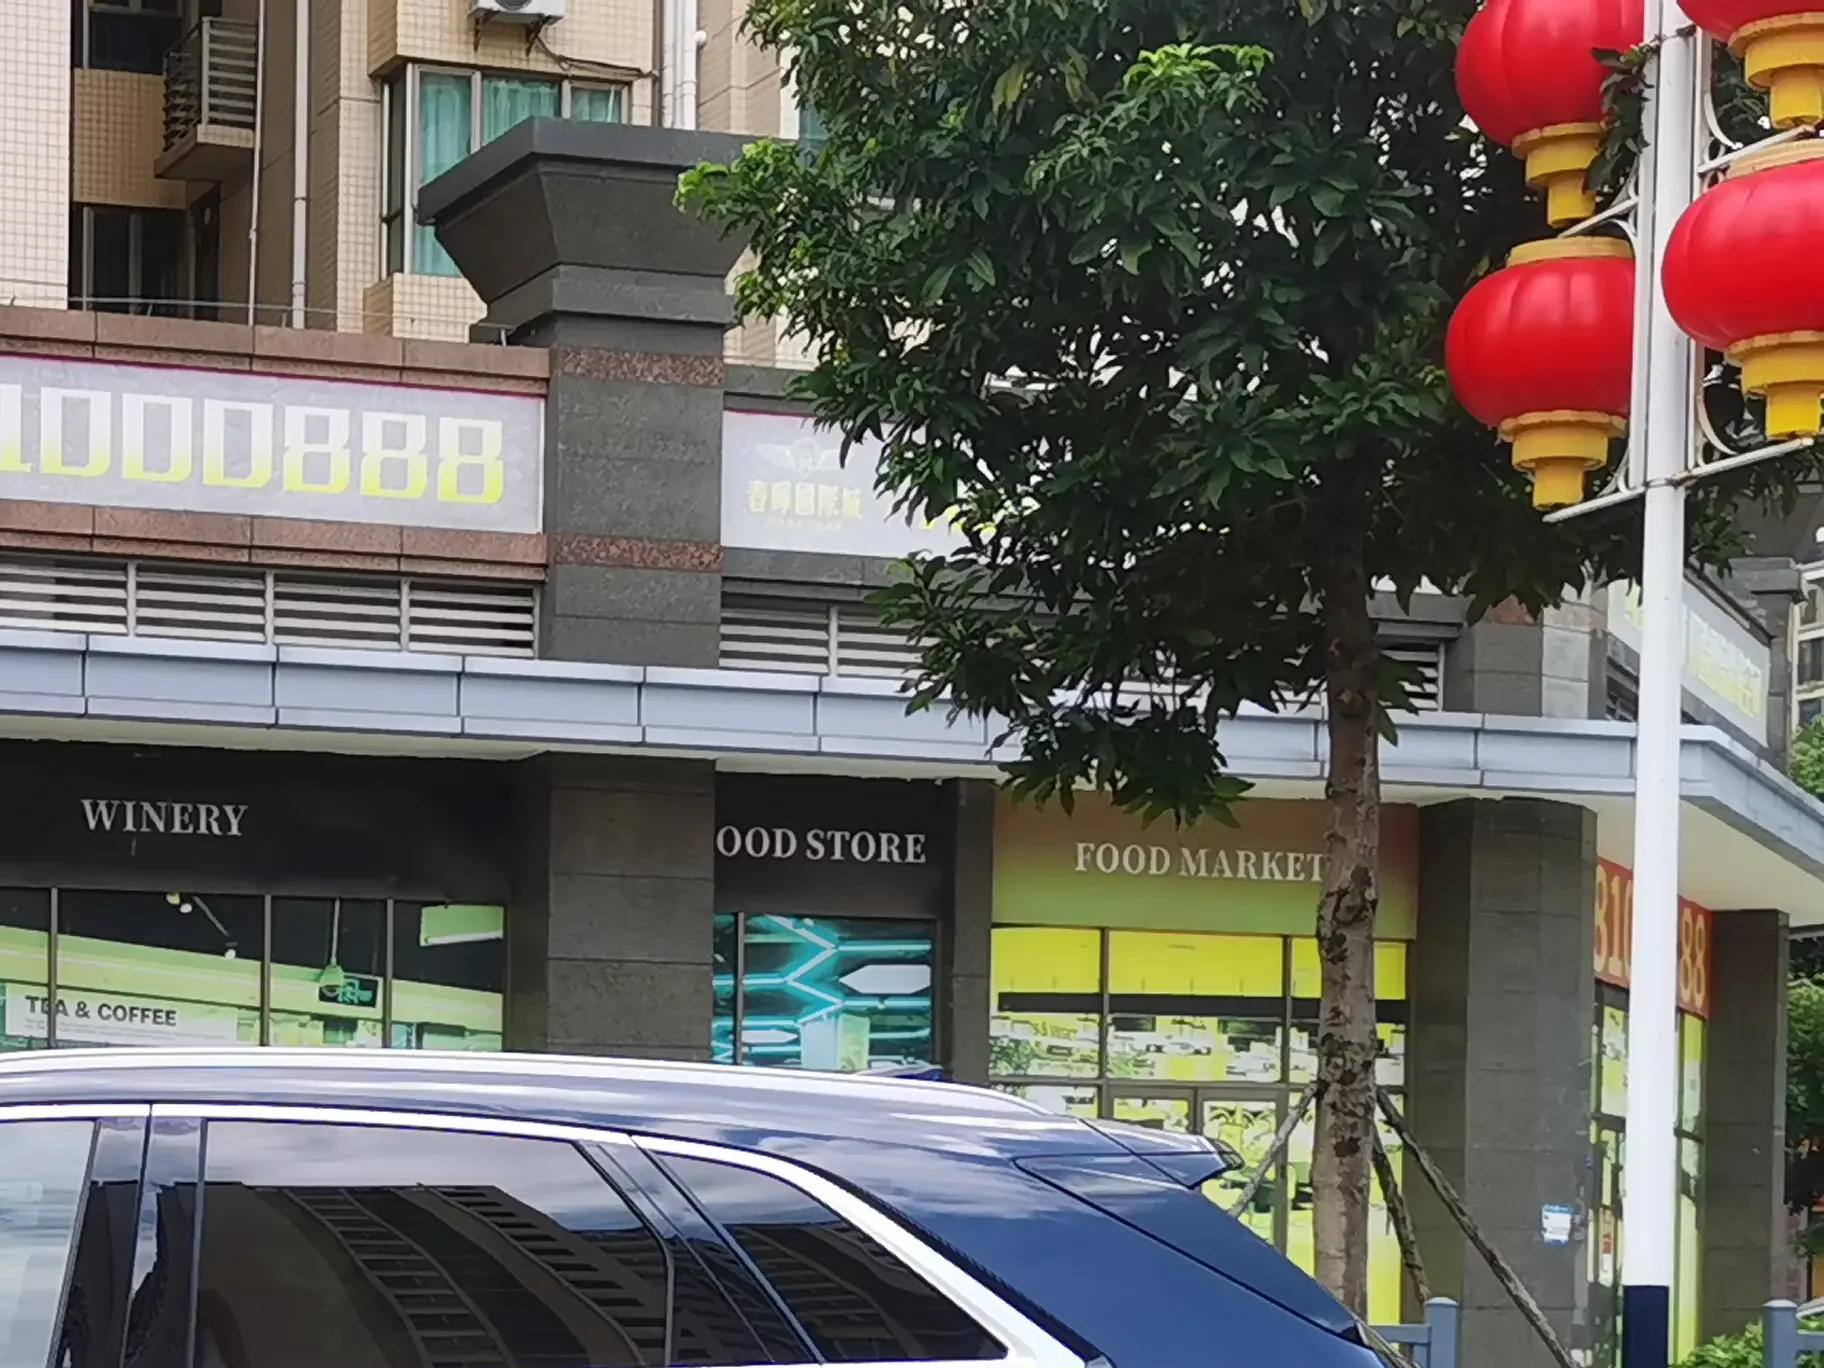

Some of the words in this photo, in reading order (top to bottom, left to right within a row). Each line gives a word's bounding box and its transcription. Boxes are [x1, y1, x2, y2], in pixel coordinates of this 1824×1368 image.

[81, 799, 249, 838] WINERY
[805, 829, 926, 863] STORE
[1075, 842, 1171, 876] FOOD
[1178, 847, 1324, 883] MARKET
[74, 1001, 91, 1020] &
[97, 1003, 177, 1027] COFFEE
